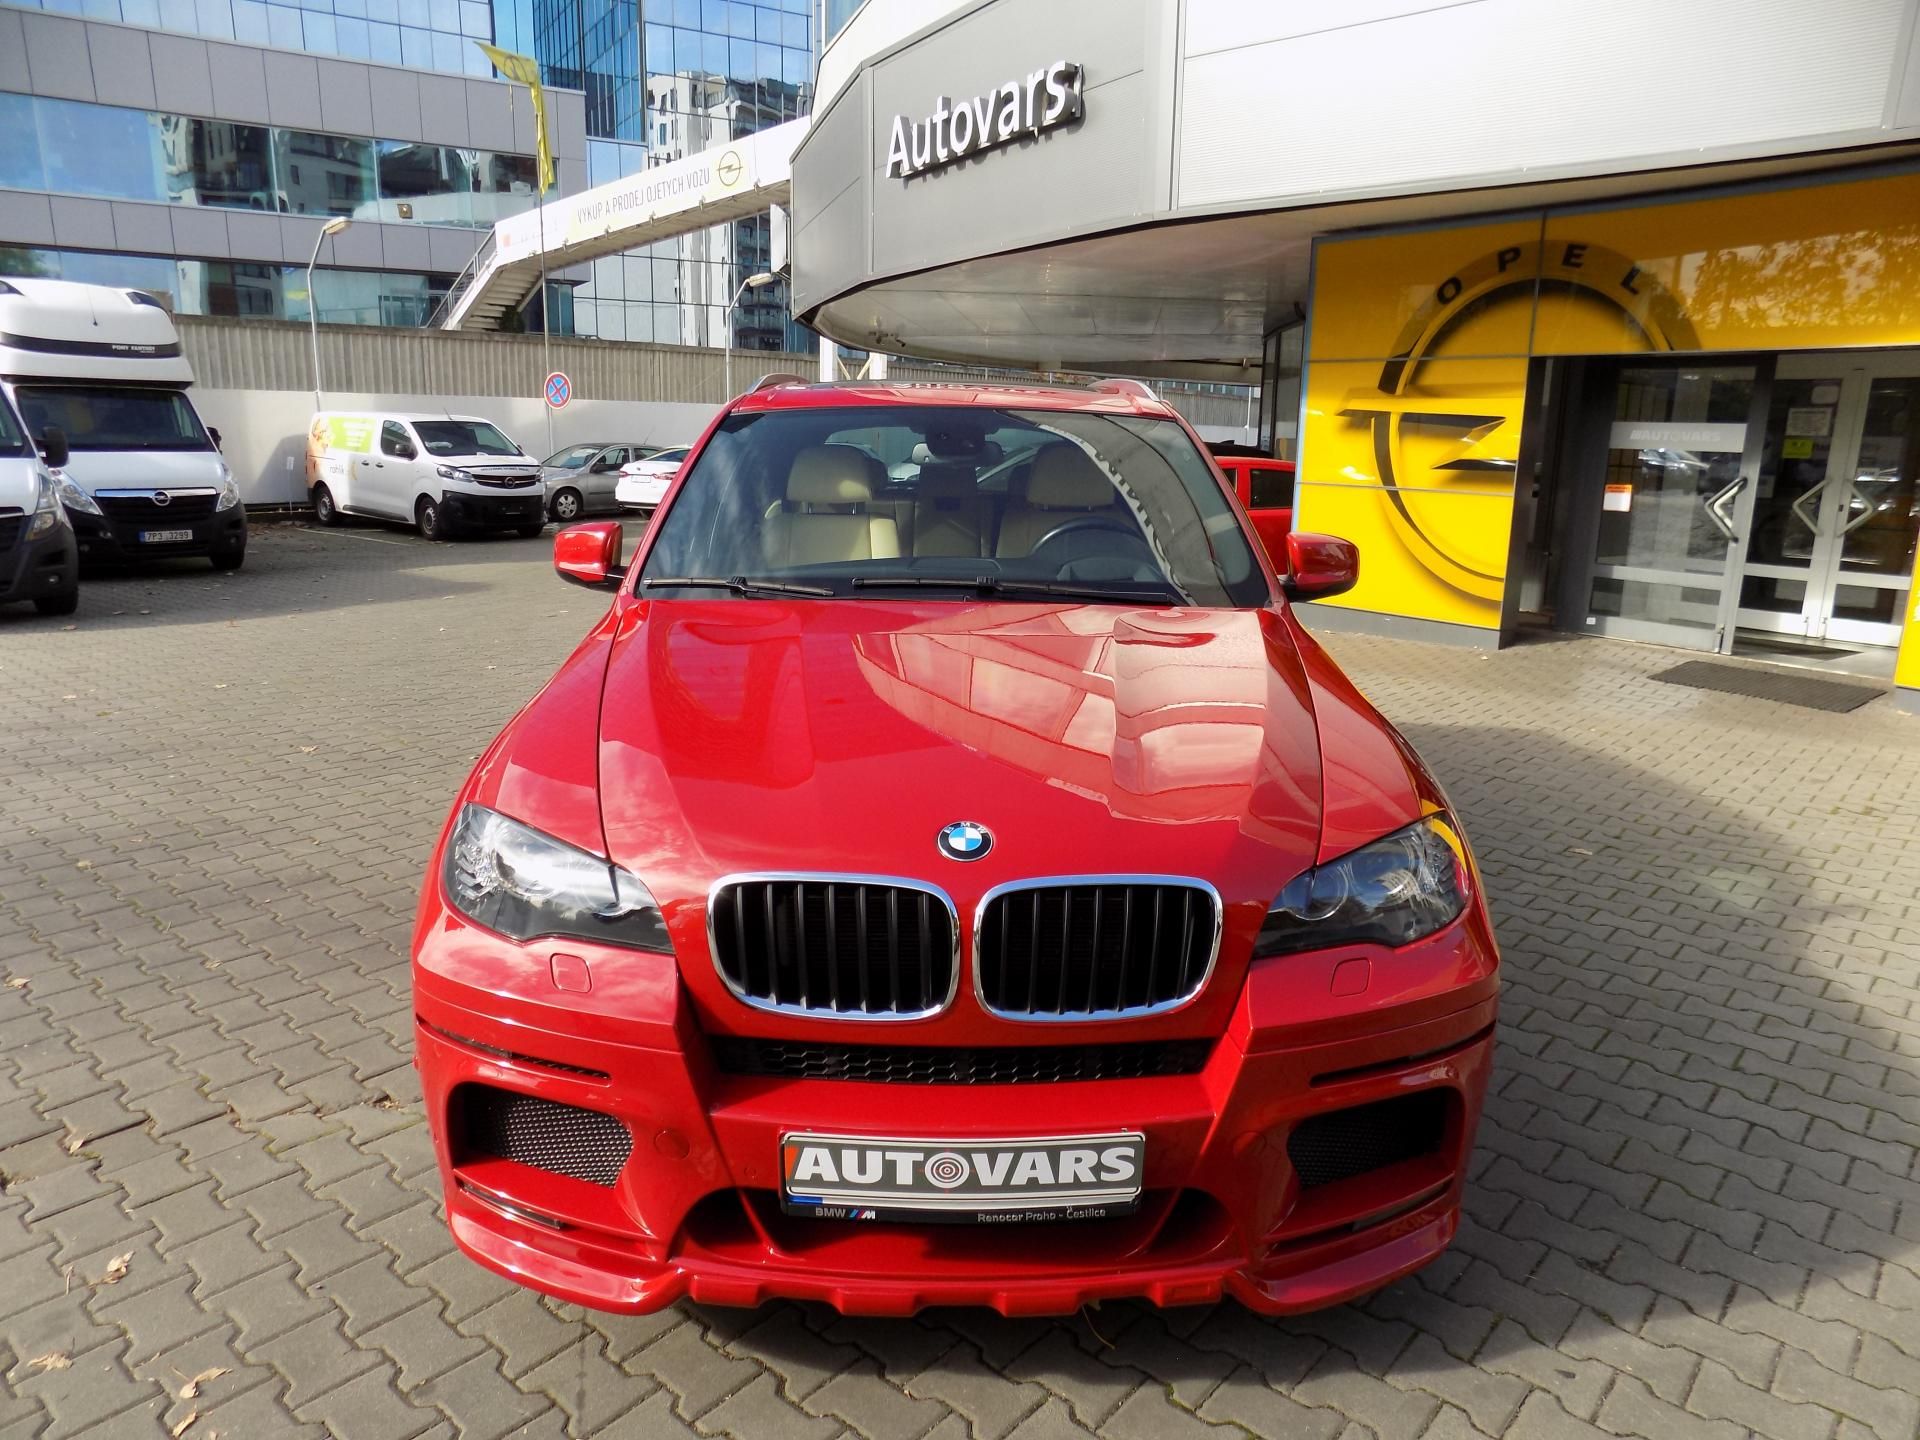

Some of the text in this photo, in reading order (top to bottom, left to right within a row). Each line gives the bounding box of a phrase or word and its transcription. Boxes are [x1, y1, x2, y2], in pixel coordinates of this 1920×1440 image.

[886, 60, 1066, 178] Autovars
[612, 188, 644, 213] PRODEJ
[1436, 243, 1641, 305] OPEL
[793, 1146, 1135, 1189] AUTOVARS
[815, 1207, 847, 1218] BMW
[977, 1212, 1023, 1223] Renocar
[1025, 1210, 1056, 1222] Praha
